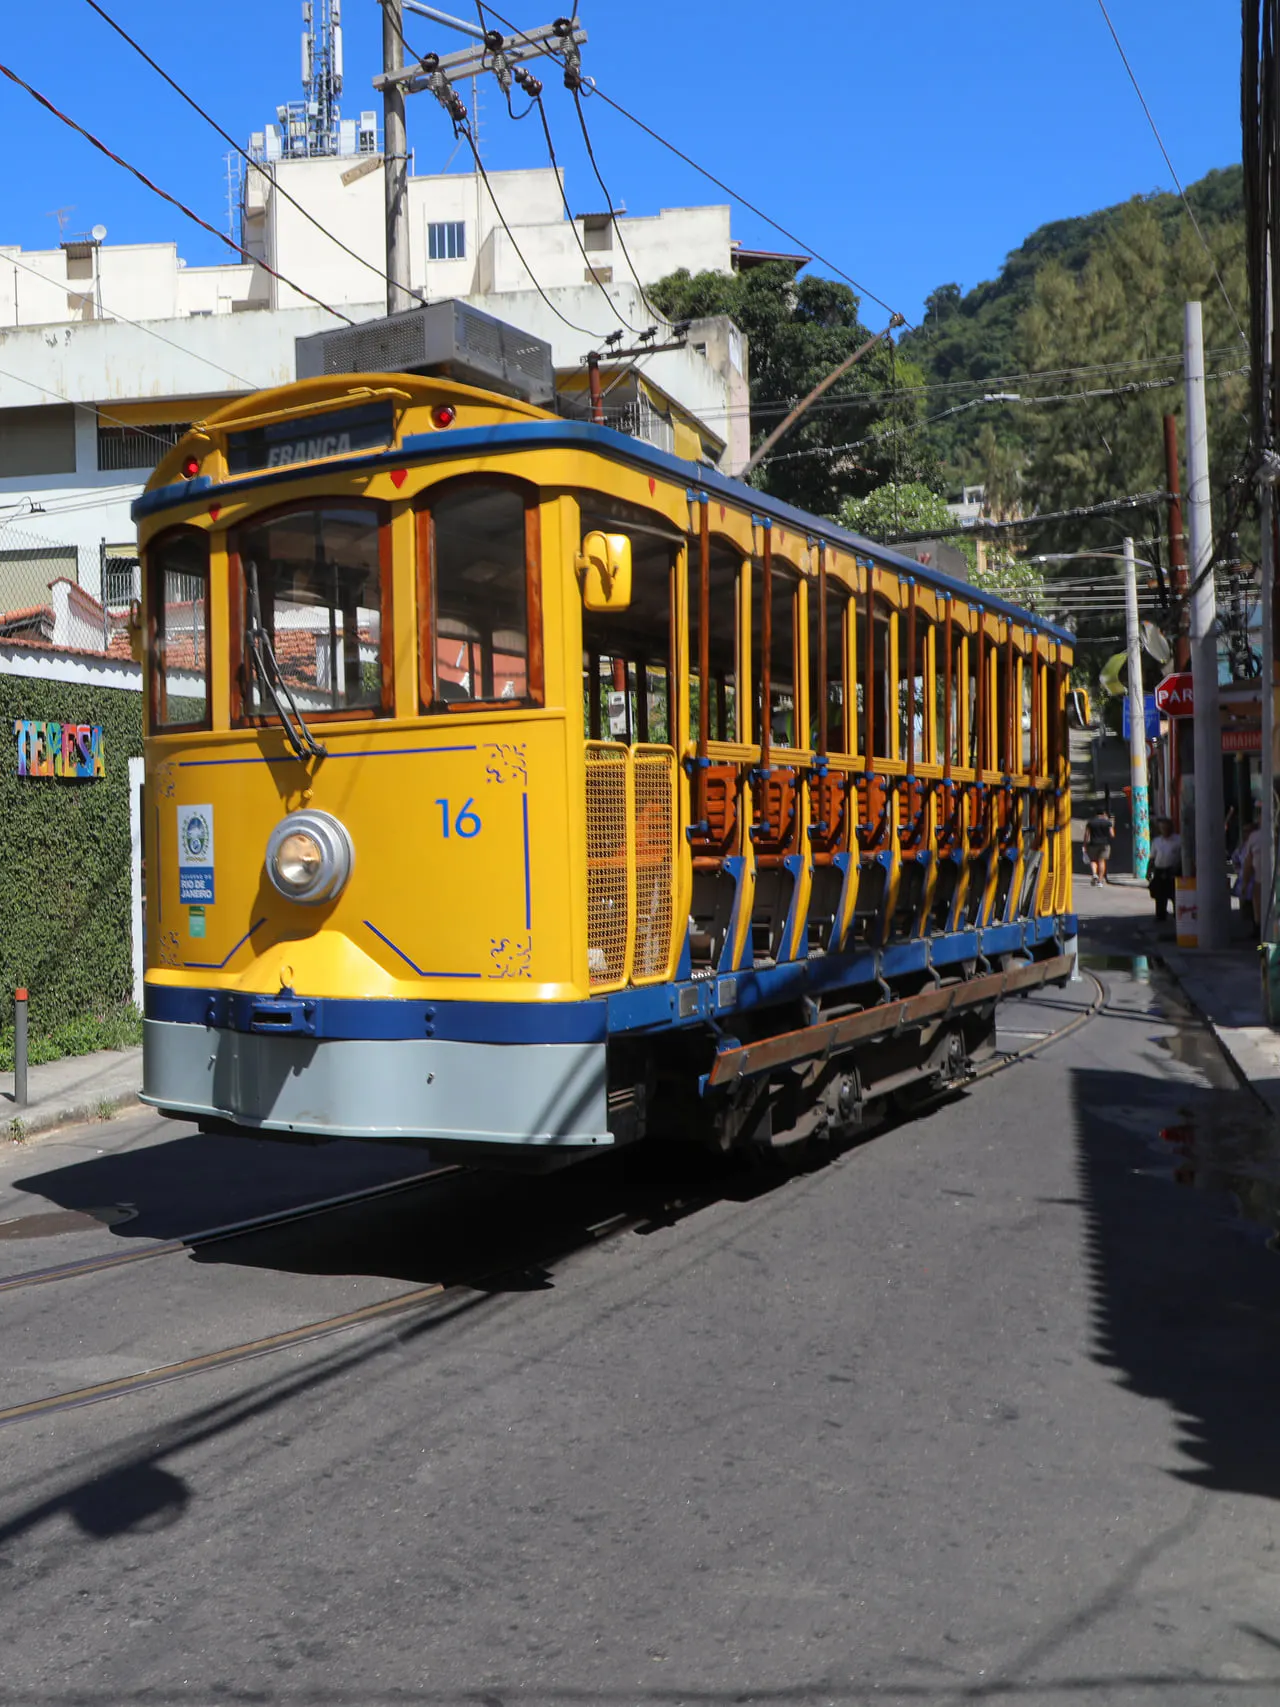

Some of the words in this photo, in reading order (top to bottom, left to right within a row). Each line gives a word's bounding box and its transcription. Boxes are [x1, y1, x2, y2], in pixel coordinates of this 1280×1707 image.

[1159, 689, 1193, 704] PAR
[15, 719, 106, 777] TERESA
[1222, 731, 1262, 749] BRAHM
[435, 797, 482, 839] 16
[181, 880, 194, 889] RIO
[195, 880, 205, 888] DE
[180, 889, 212, 899] JANEIRO
